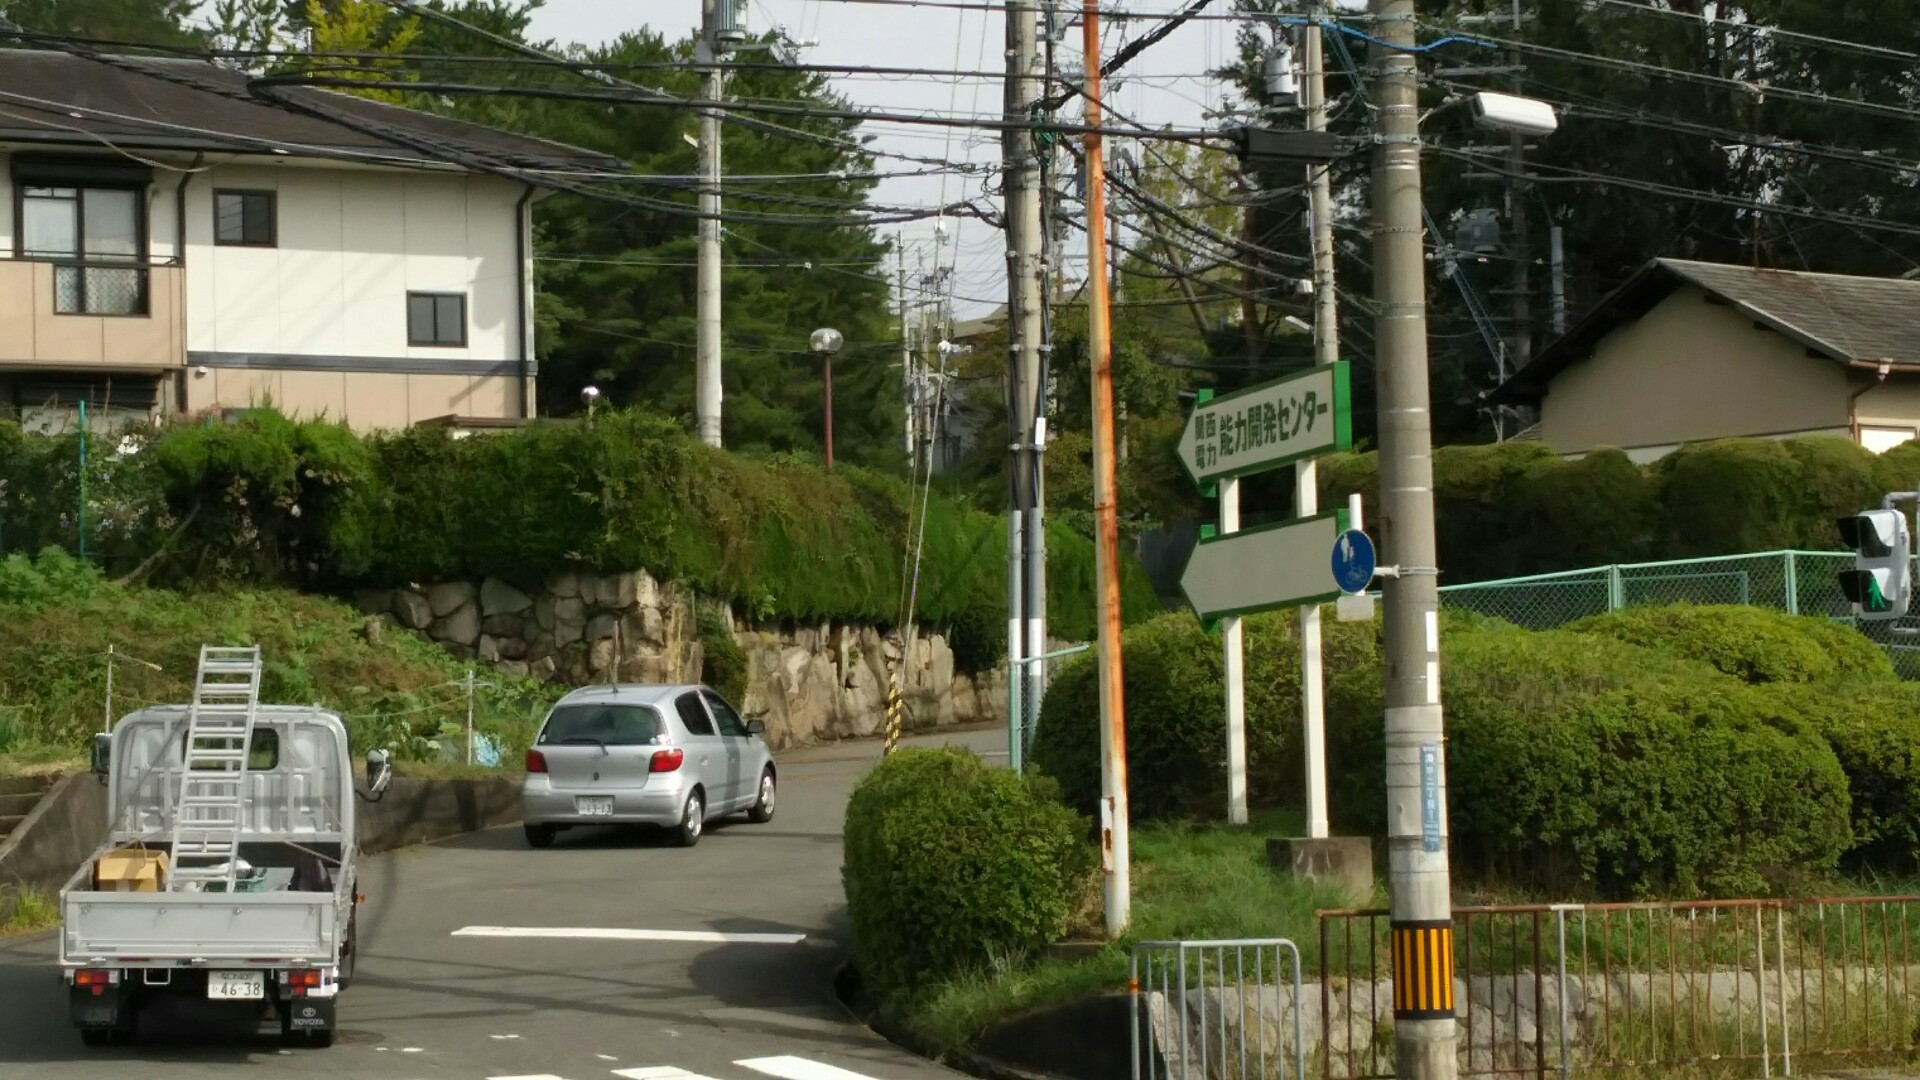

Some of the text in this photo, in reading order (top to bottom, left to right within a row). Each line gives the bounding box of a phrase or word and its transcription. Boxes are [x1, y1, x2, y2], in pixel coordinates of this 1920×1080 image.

[1195, 412, 1216, 440] 関西
[1220, 391, 1328, 457] 能力開発センター
[1196, 442, 1217, 469] 電力
[220, 981, 261, 996] 46-38
[293, 1018, 325, 1027] TOYOTA
